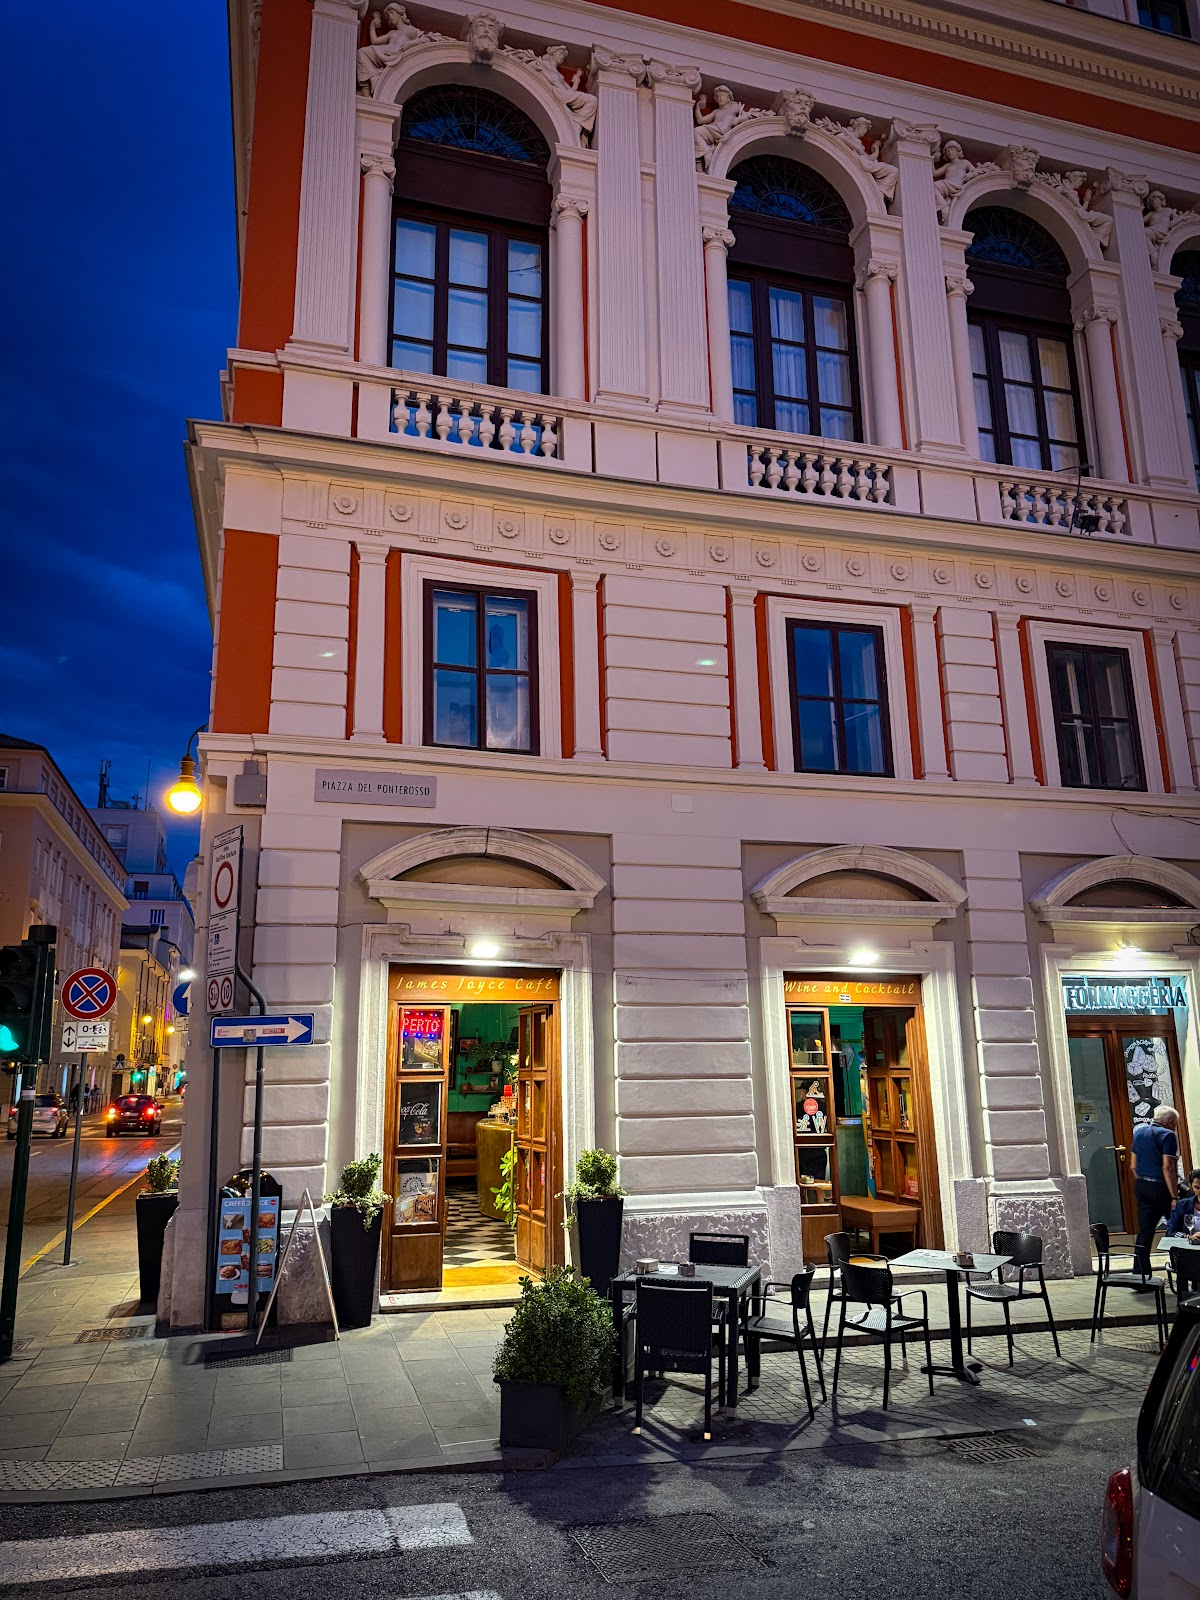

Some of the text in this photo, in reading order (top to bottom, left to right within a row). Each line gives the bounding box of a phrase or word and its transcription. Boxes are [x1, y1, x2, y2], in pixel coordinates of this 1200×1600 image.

[322, 780, 430, 796] PIAZZA DEL PONTEROSSO
[396, 976, 553, 995] James Joyce Café
[784, 981, 915, 994] Wine and Cocktail
[1063, 985, 1187, 1008] FORMAGGERIA
[402, 1018, 440, 1032] PERTO
